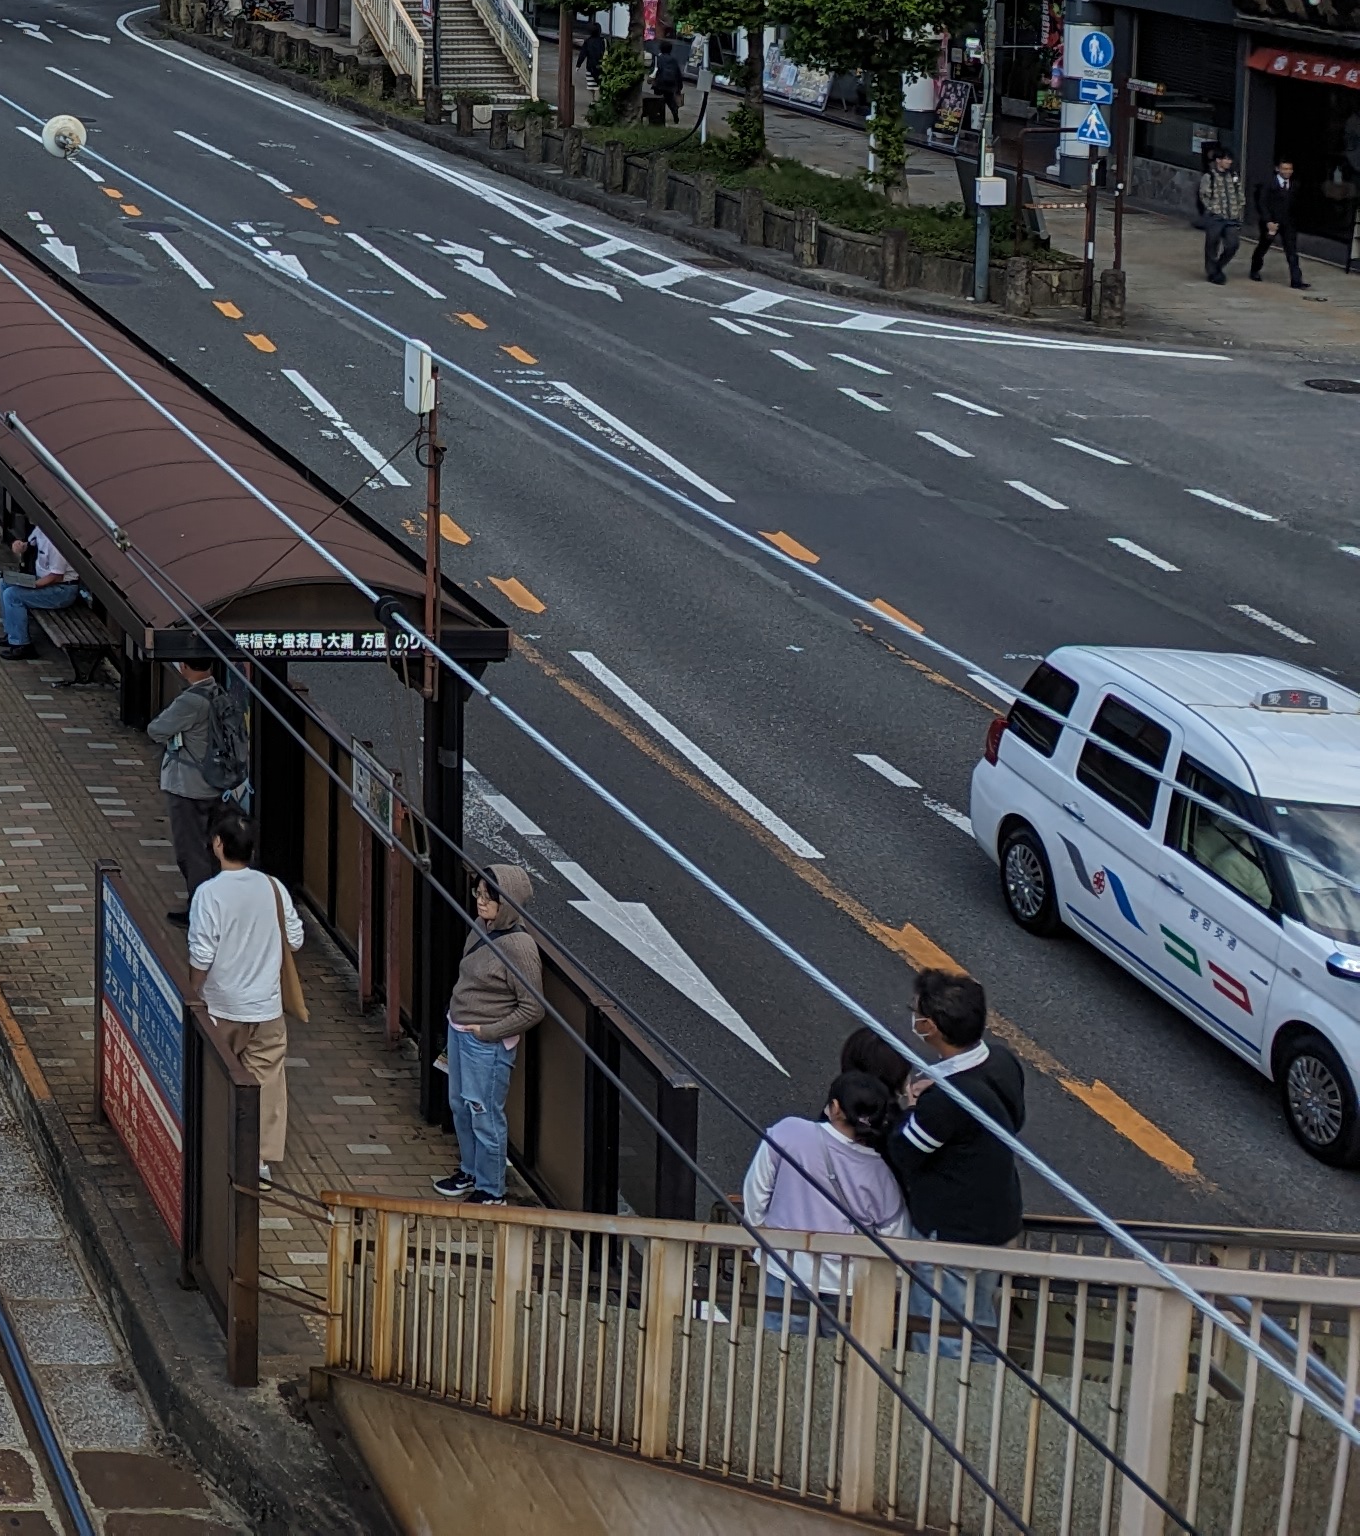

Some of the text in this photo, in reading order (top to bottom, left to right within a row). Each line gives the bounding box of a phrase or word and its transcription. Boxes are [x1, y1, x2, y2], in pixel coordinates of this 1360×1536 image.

[235, 632, 354, 650] 崇福寺・蛍茶屋・大浦
[361, 632, 387, 649] 方面
